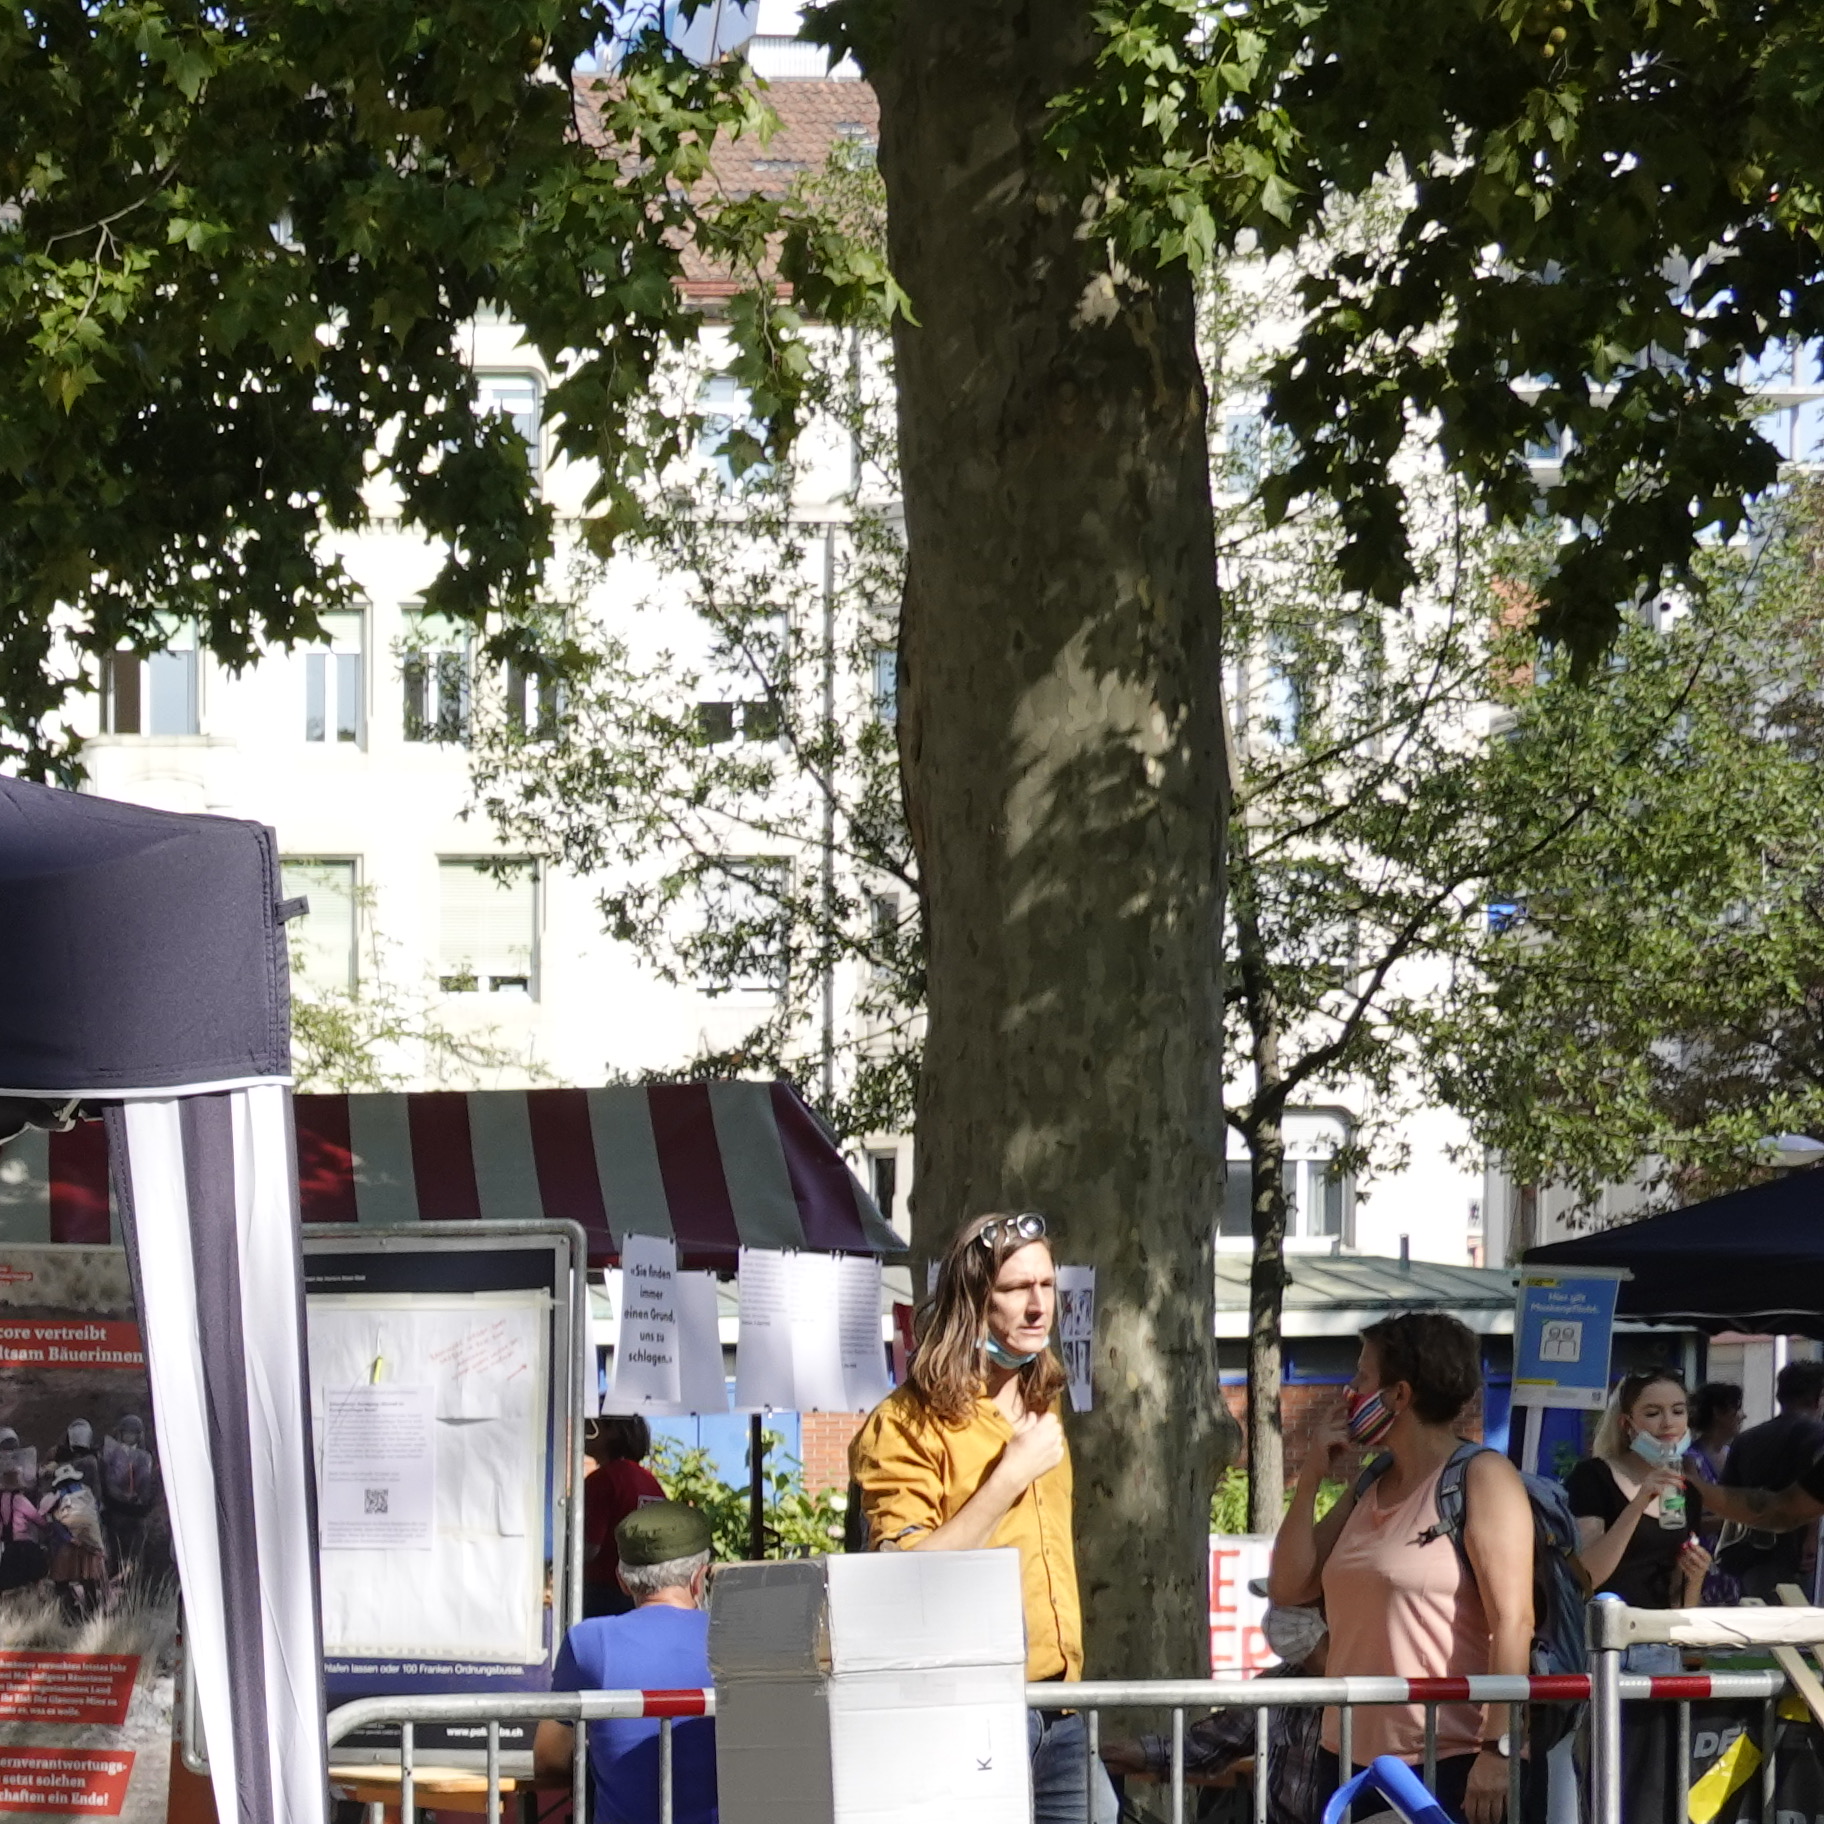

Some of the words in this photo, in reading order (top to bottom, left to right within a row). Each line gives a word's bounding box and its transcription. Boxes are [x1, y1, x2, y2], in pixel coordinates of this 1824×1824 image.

[648, 1265, 671, 1280] finden
[639, 1285, 663, 1301] immer
[624, 1307, 648, 1320] einen
[34, 1324, 107, 1341] vertreibt
[639, 1330, 652, 1343] uns
[47, 1345, 144, 1364] Bäuerinnen
[351, 1663, 378, 1674] lassen
[379, 1664, 400, 1674] oder
[402, 1664, 417, 1674] 100
[419, 1664, 453, 1675] Franken
[35, 1773, 86, 1788] solchen
[47, 1789, 68, 1804] ein
